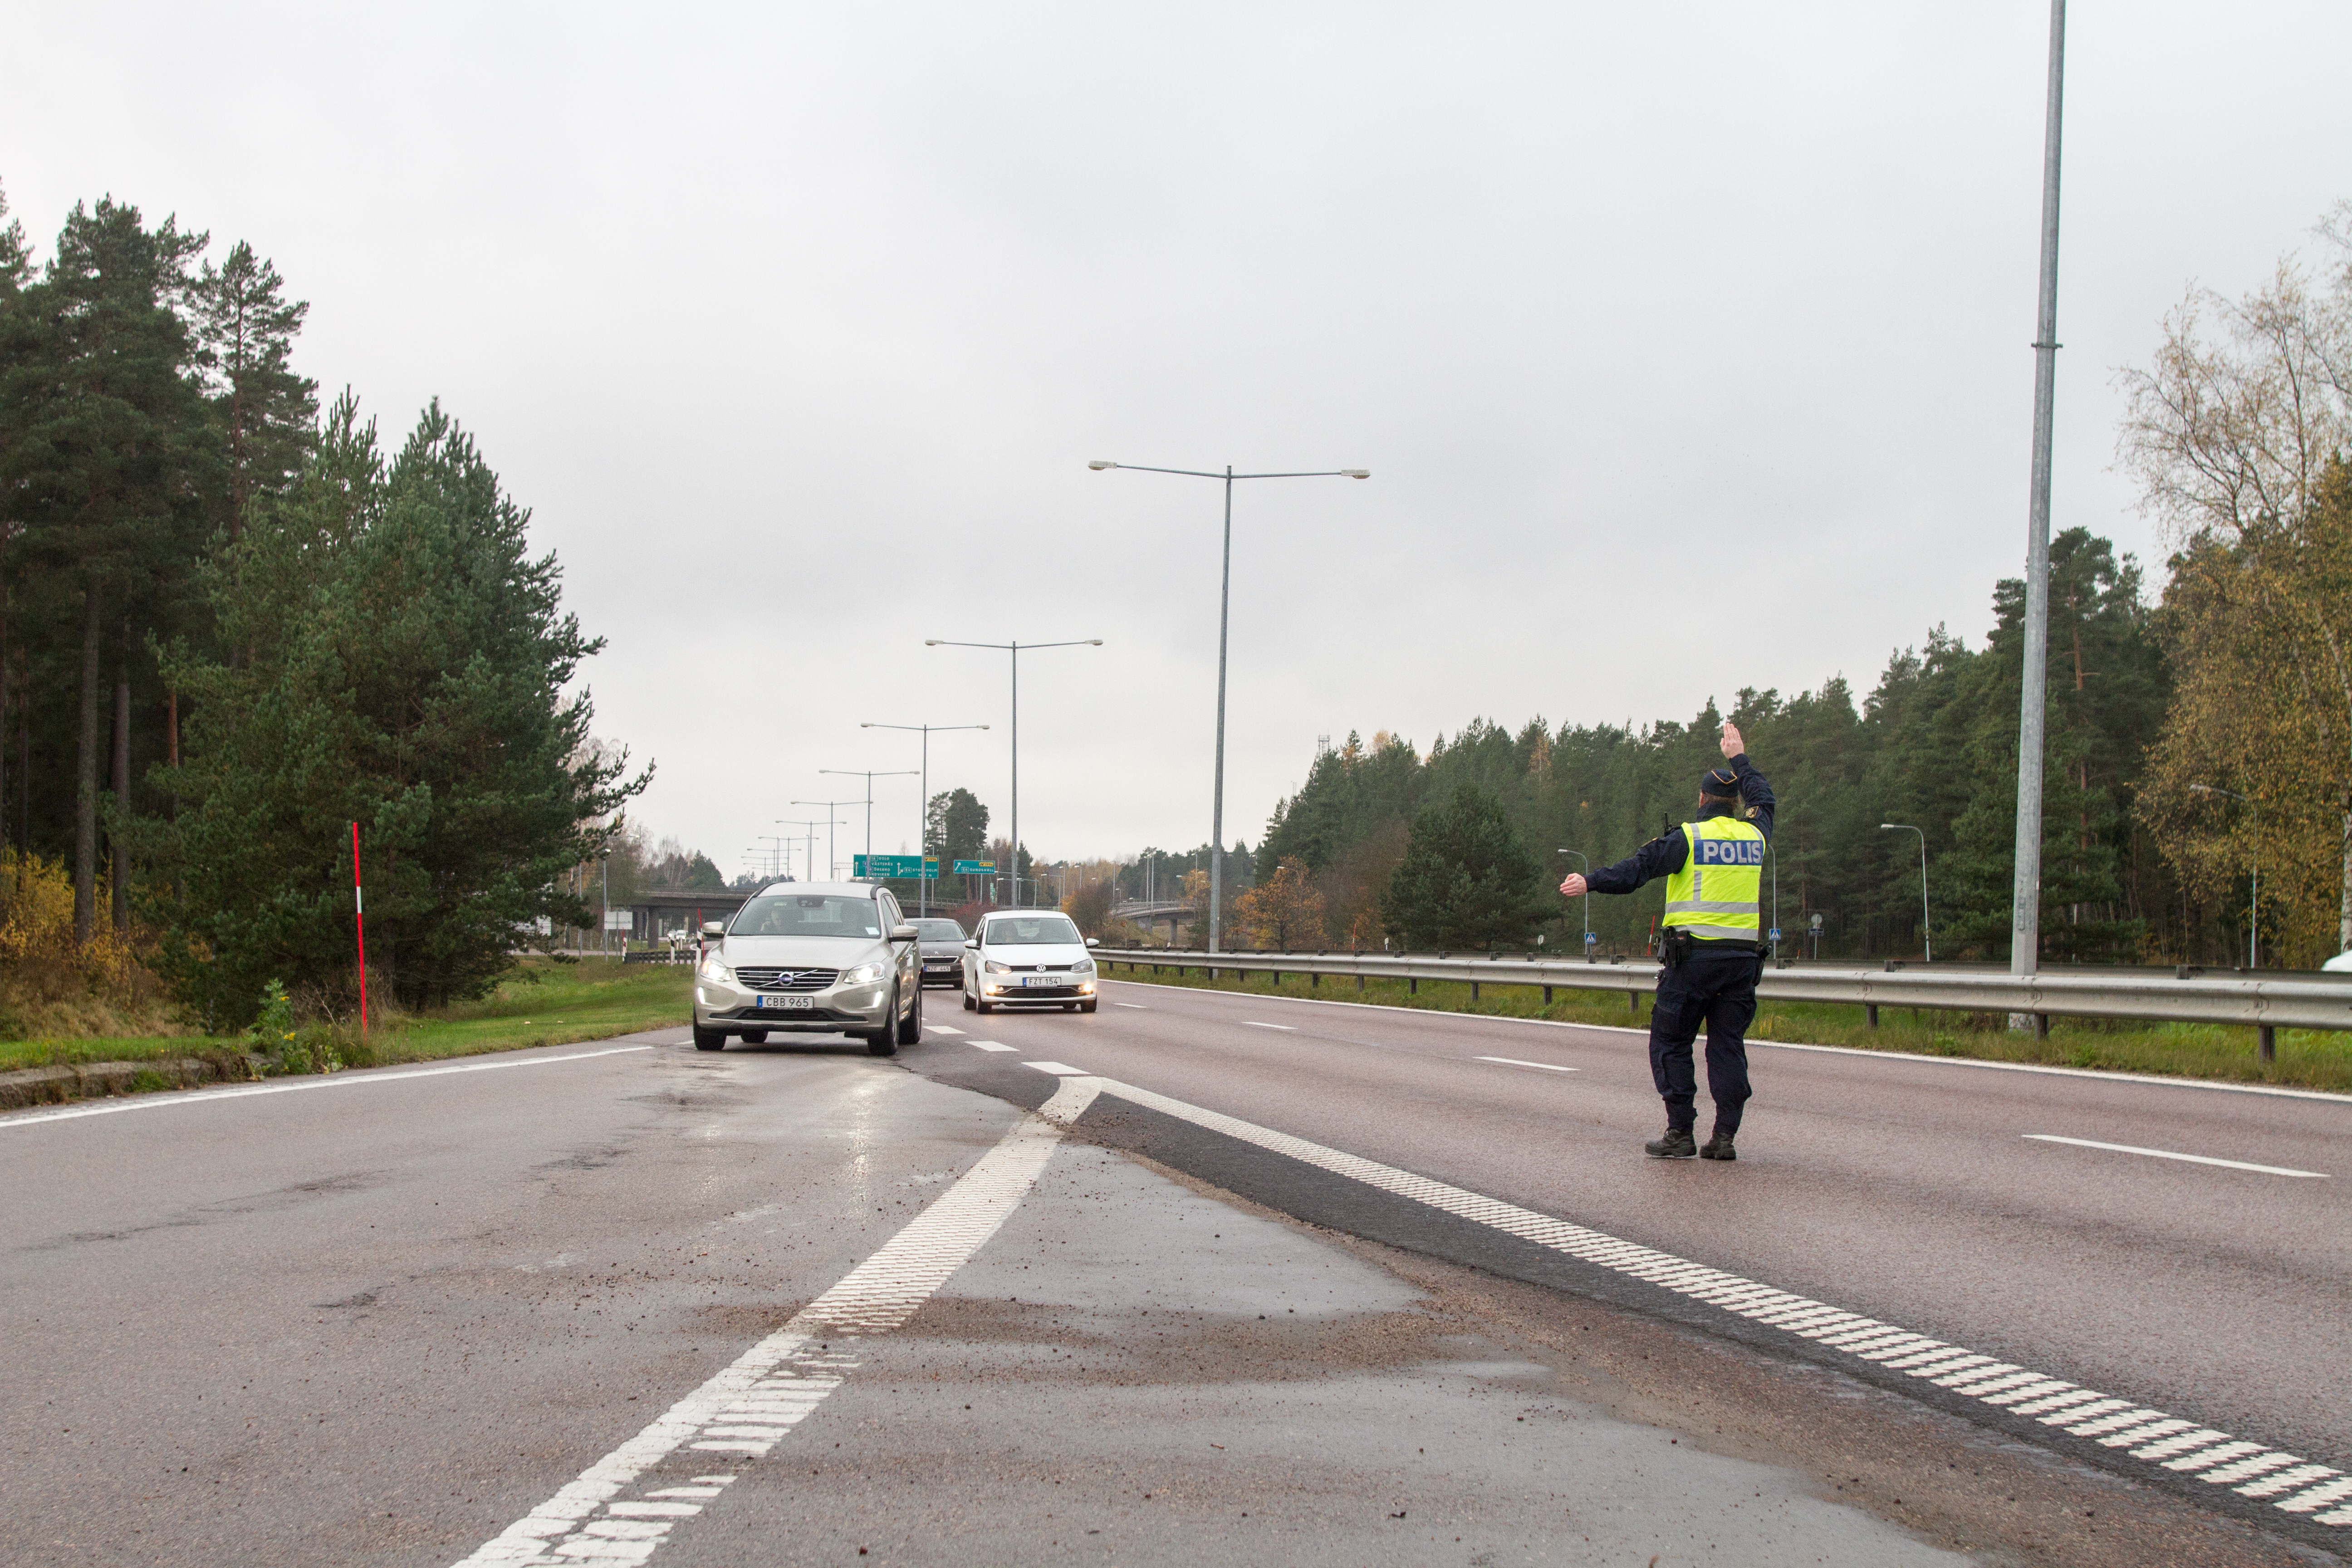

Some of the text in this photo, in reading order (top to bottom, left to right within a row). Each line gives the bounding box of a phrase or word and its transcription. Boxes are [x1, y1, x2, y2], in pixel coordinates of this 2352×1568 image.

[1703, 841, 1761, 863] POLIS
[767, 998, 785, 1006] CBB
[789, 998, 808, 1007] 965
